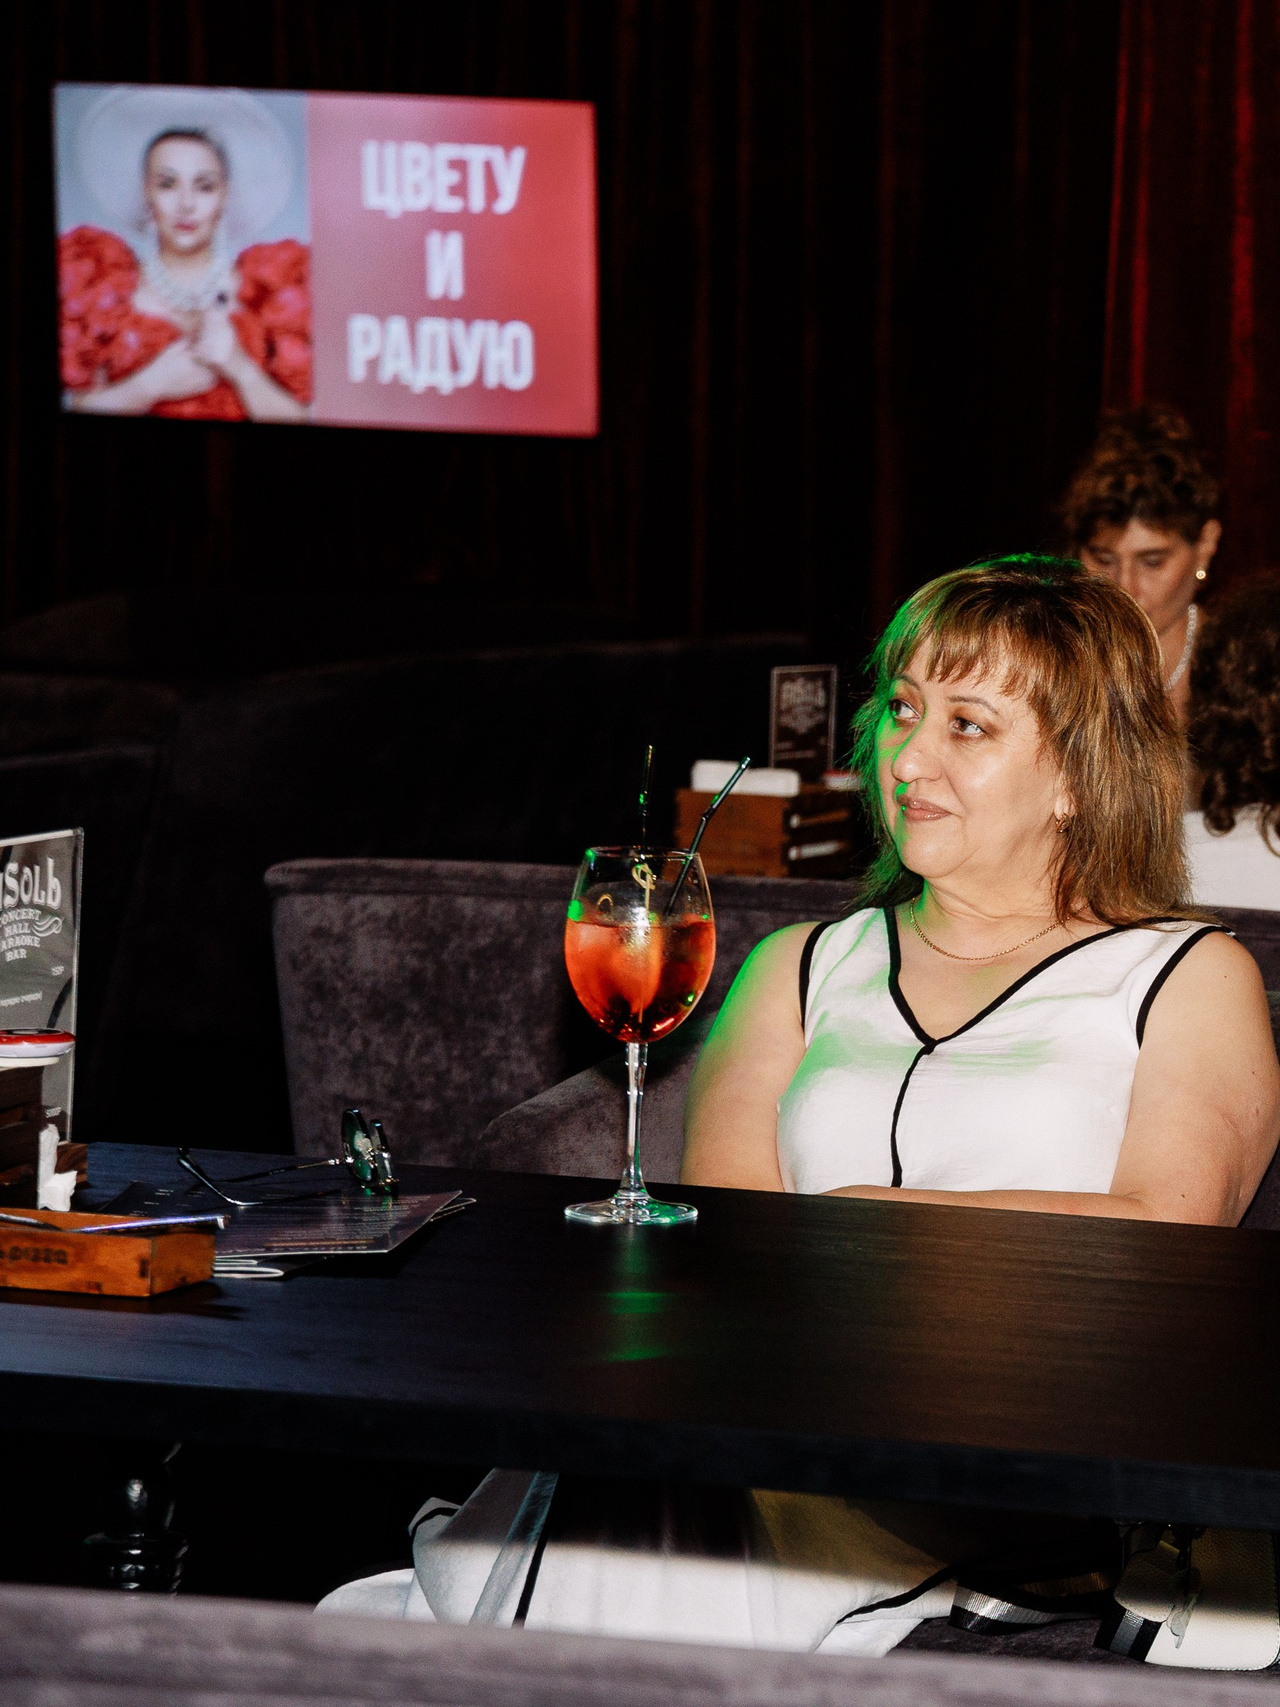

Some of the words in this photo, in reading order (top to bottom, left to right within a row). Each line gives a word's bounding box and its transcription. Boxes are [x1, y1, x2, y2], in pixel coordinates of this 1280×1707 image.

[361, 139, 527, 218] ЦВЕТУ
[425, 229, 464, 300] И
[347, 313, 536, 395] РАДУЮ
[0, 908, 41, 928] ONCERT
[4, 922, 31, 938] HALL
[0, 935, 41, 953] ARAOKE
[5, 948, 27, 962] BAR
